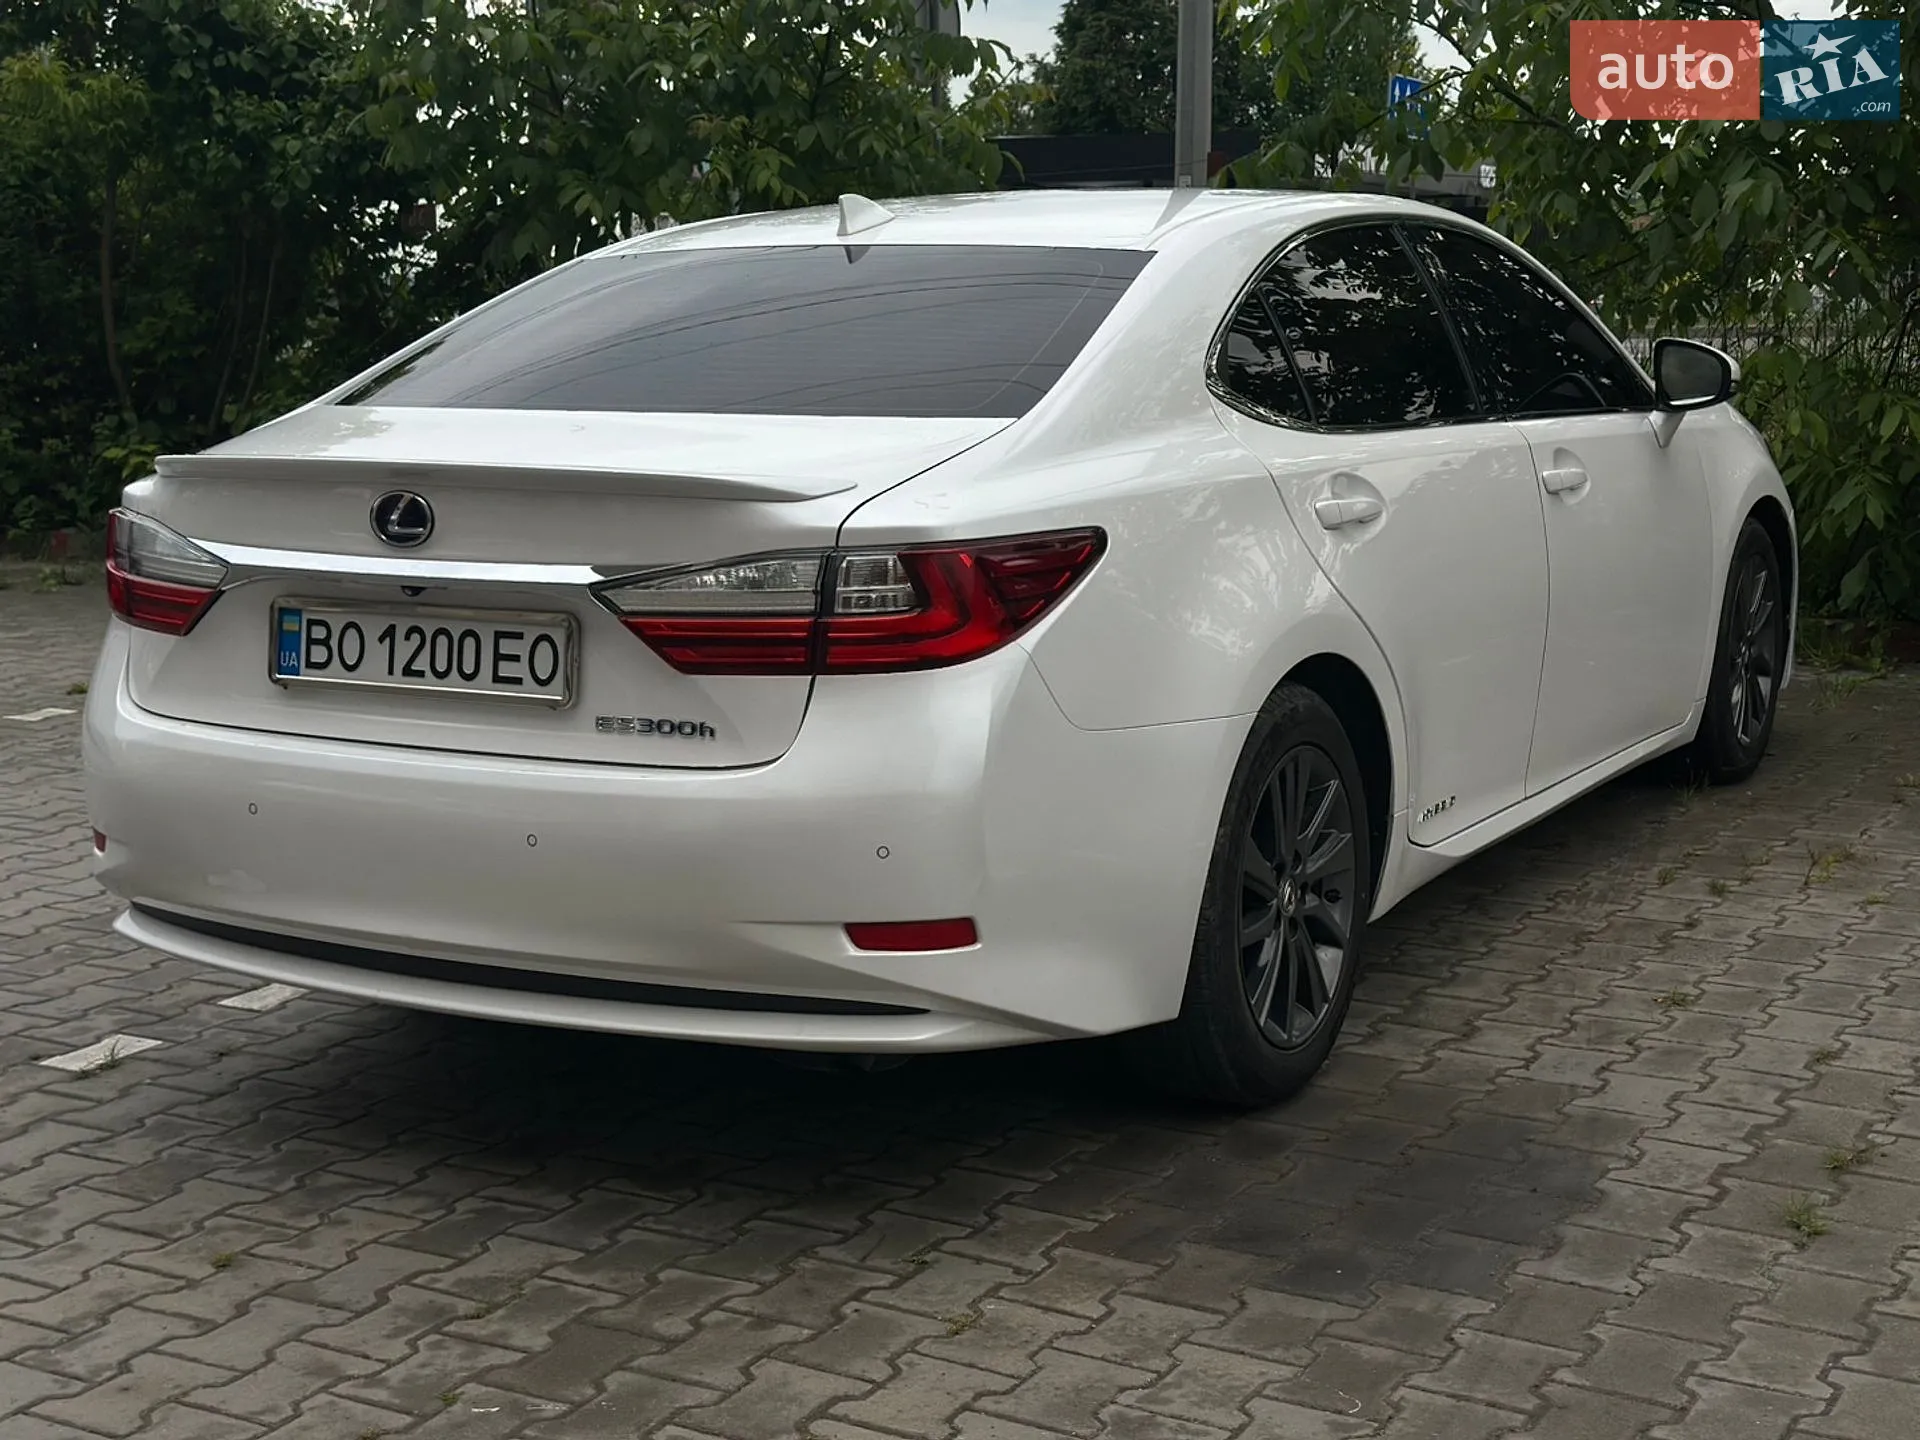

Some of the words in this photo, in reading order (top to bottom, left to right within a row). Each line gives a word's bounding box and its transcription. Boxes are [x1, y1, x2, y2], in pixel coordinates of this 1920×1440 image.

[279, 651, 299, 668] UA
[305, 618, 366, 673] BO
[377, 623, 482, 682] 1200
[492, 629, 560, 687] EO
